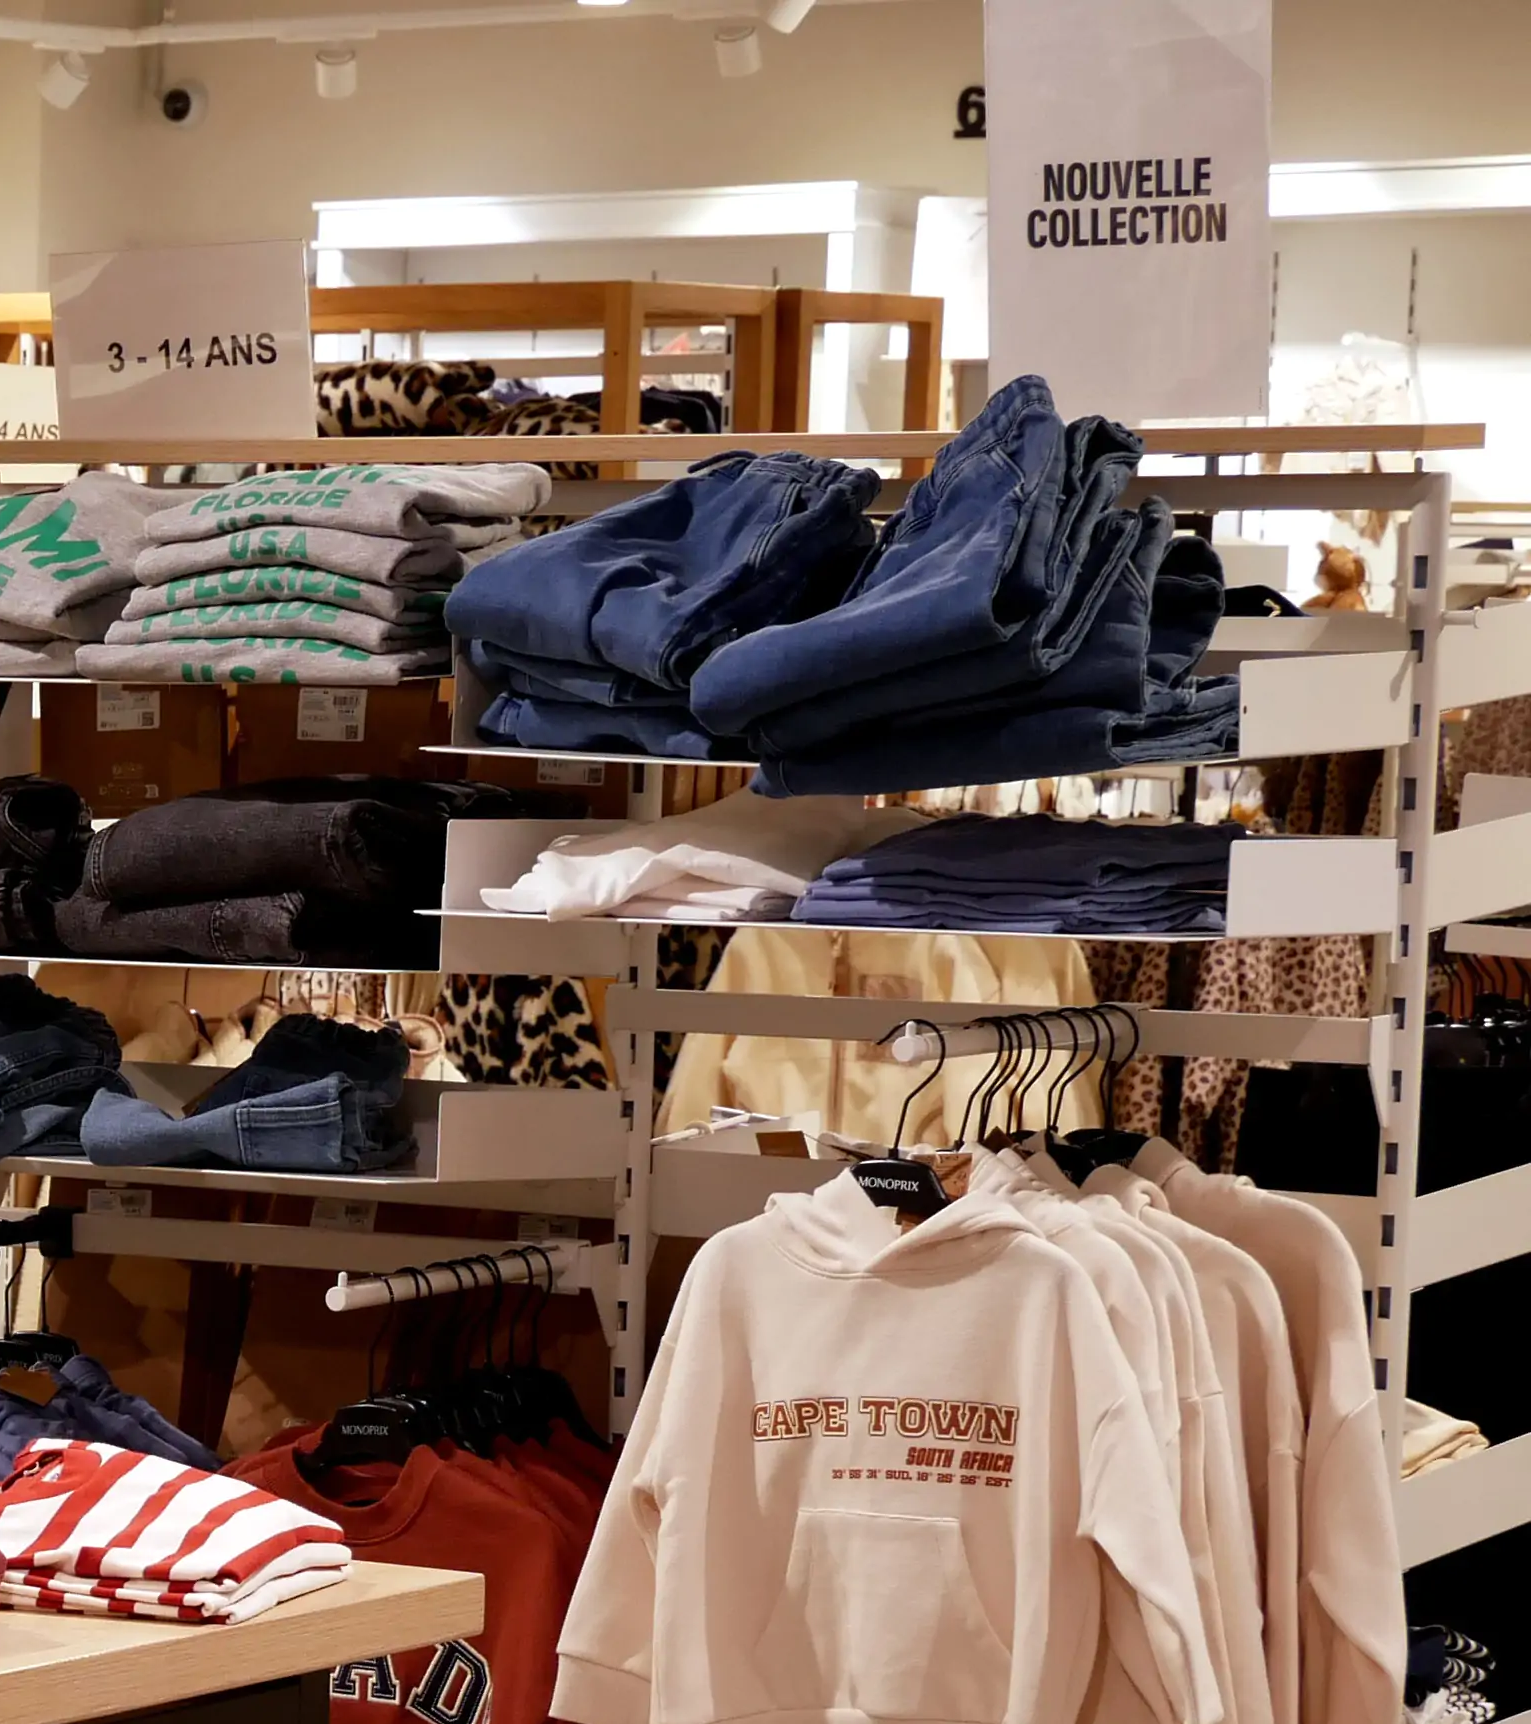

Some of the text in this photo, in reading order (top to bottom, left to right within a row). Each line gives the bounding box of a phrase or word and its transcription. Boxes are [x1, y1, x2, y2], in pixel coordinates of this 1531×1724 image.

[1043, 157, 1212, 202] NOUVELLE
[1027, 203, 1227, 249] COLLECTION
[107, 342, 125, 373] 3
[157, 337, 195, 370] 14
[204, 332, 278, 368] ANS
[15, 424, 59, 440] ANS
[190, 488, 352, 516] FLORIDE
[857, 1175, 920, 1193] MONOPRIX
[341, 1424, 389, 1436] MONOPRIX
[752, 1396, 1020, 1446] CAPE TOWN
[905, 1446, 1015, 1474] SOUTH AFRICA
[984, 1476, 1014, 1489] EST
